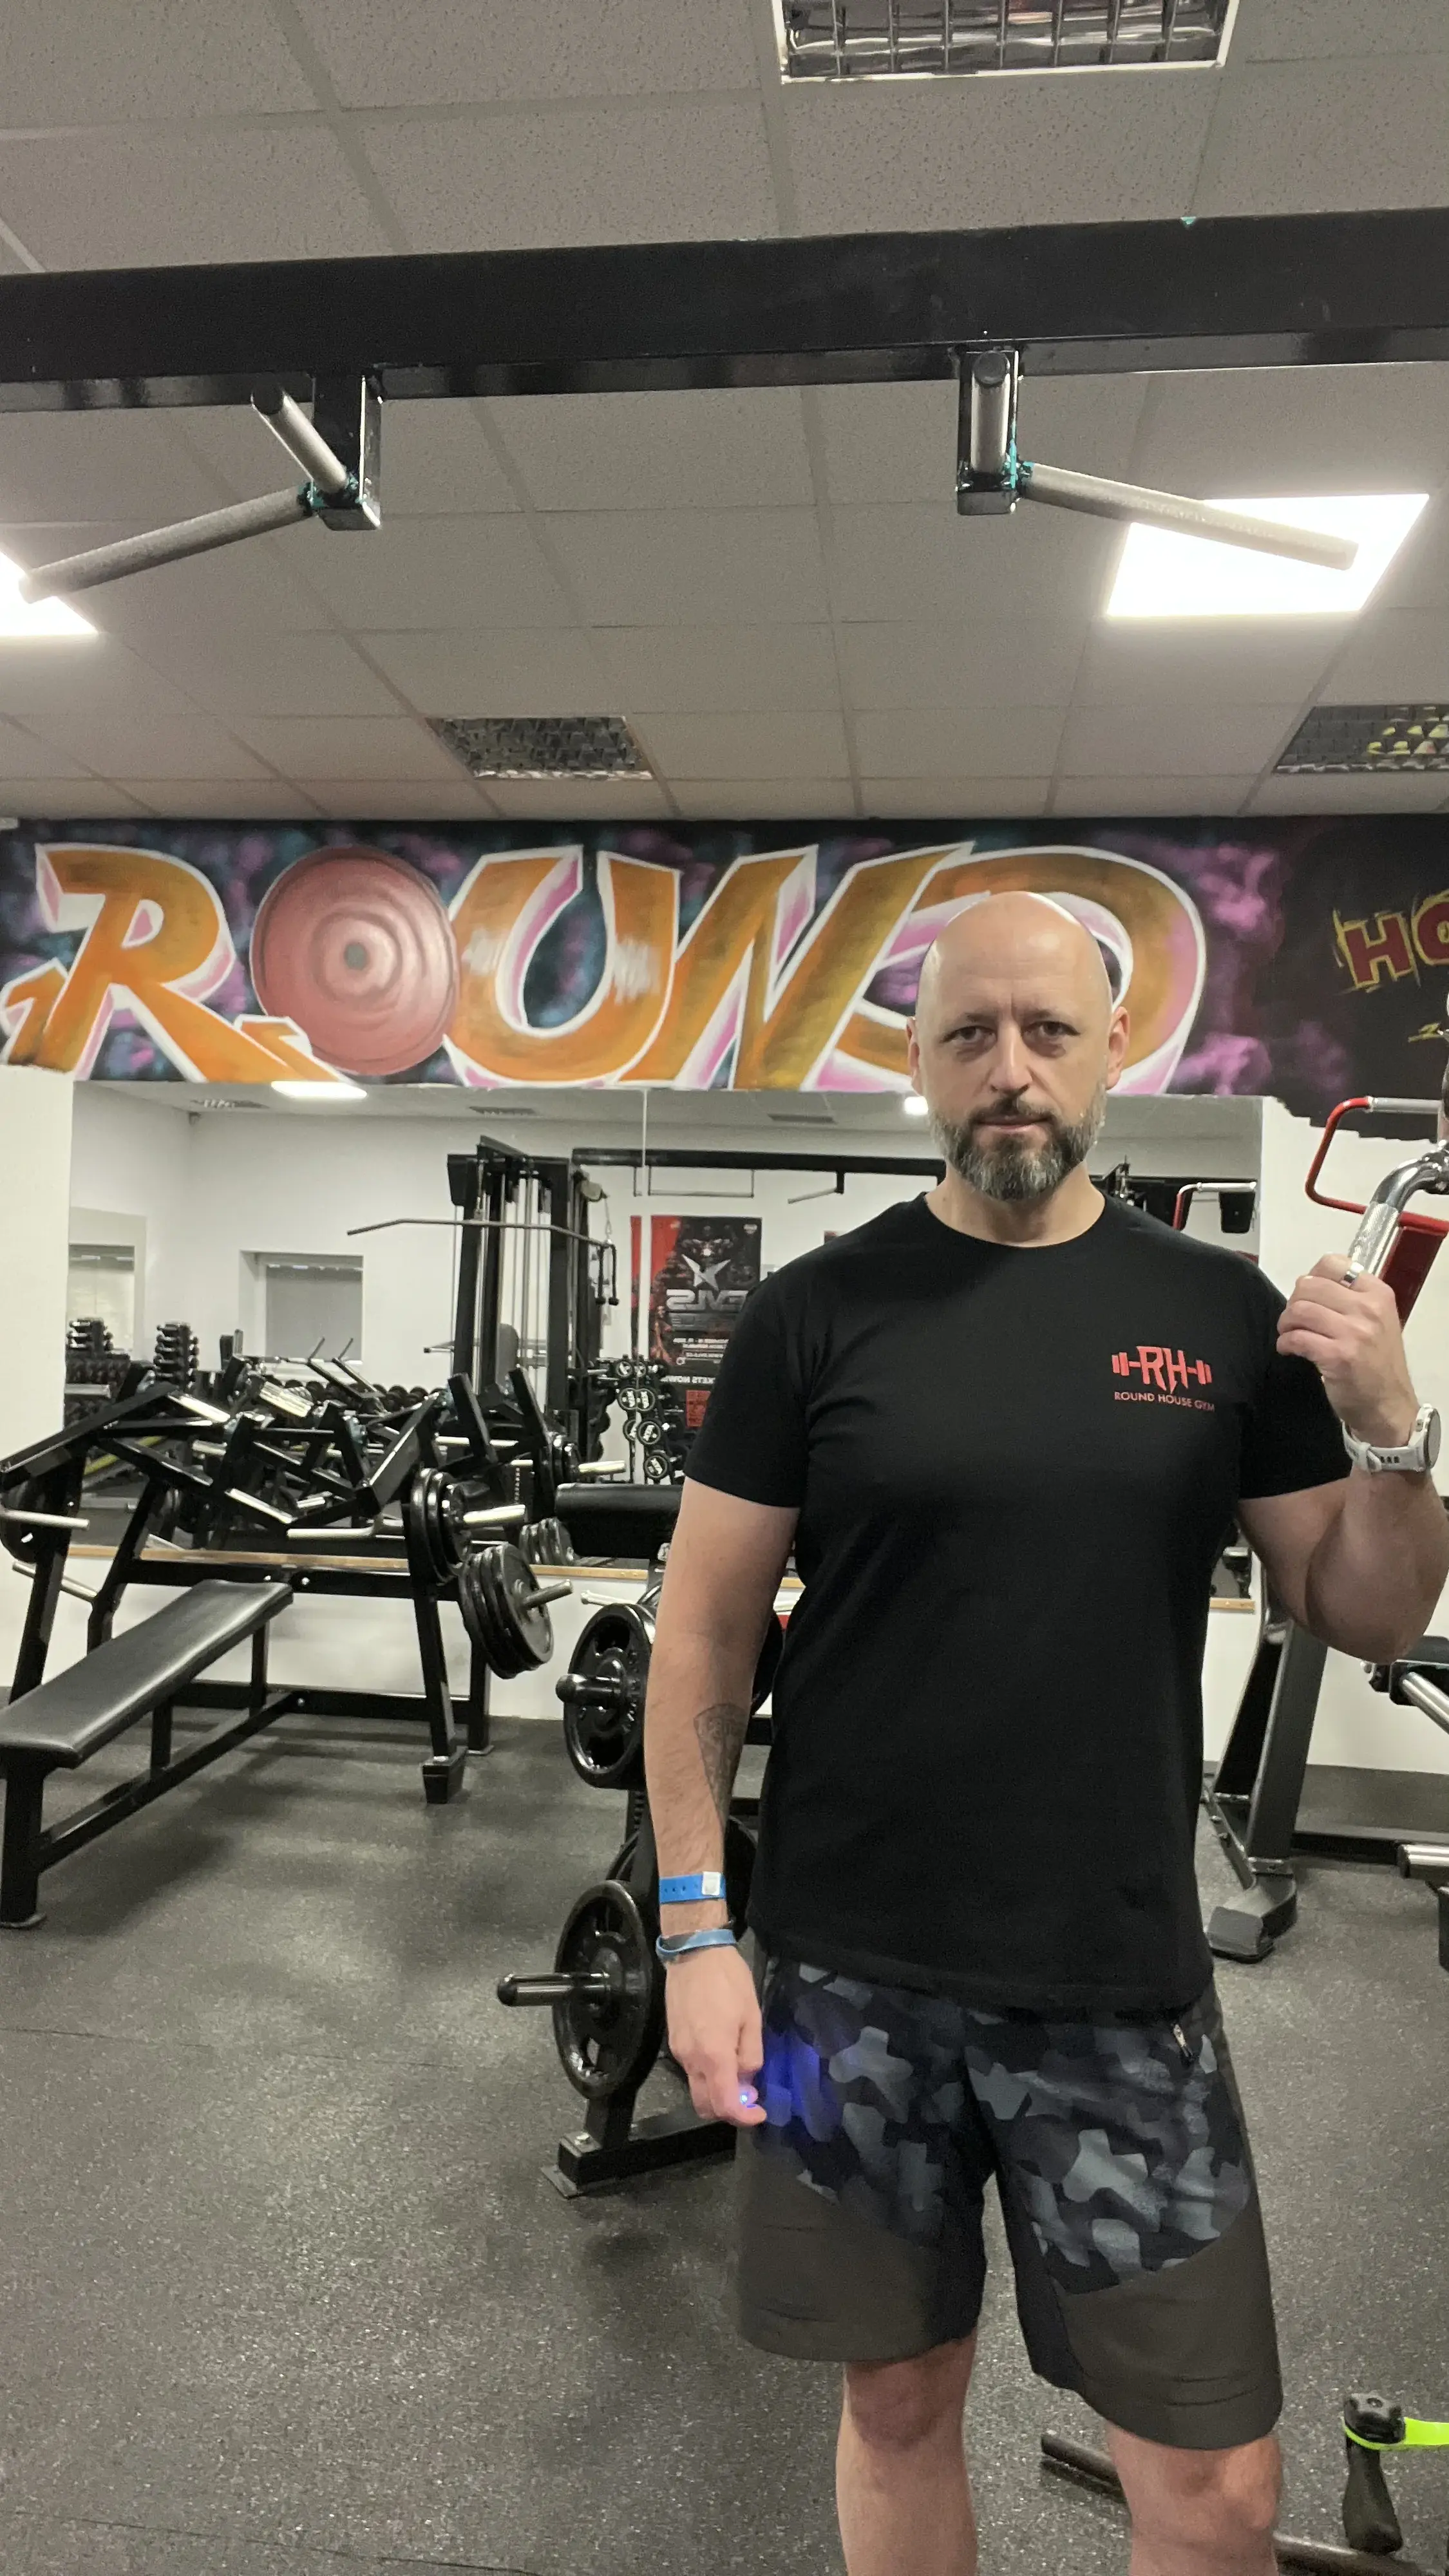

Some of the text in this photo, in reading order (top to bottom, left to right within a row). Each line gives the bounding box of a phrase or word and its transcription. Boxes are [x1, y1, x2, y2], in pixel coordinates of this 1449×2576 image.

[1114, 1391, 1215, 1412] ROUND HOUSE GYM
